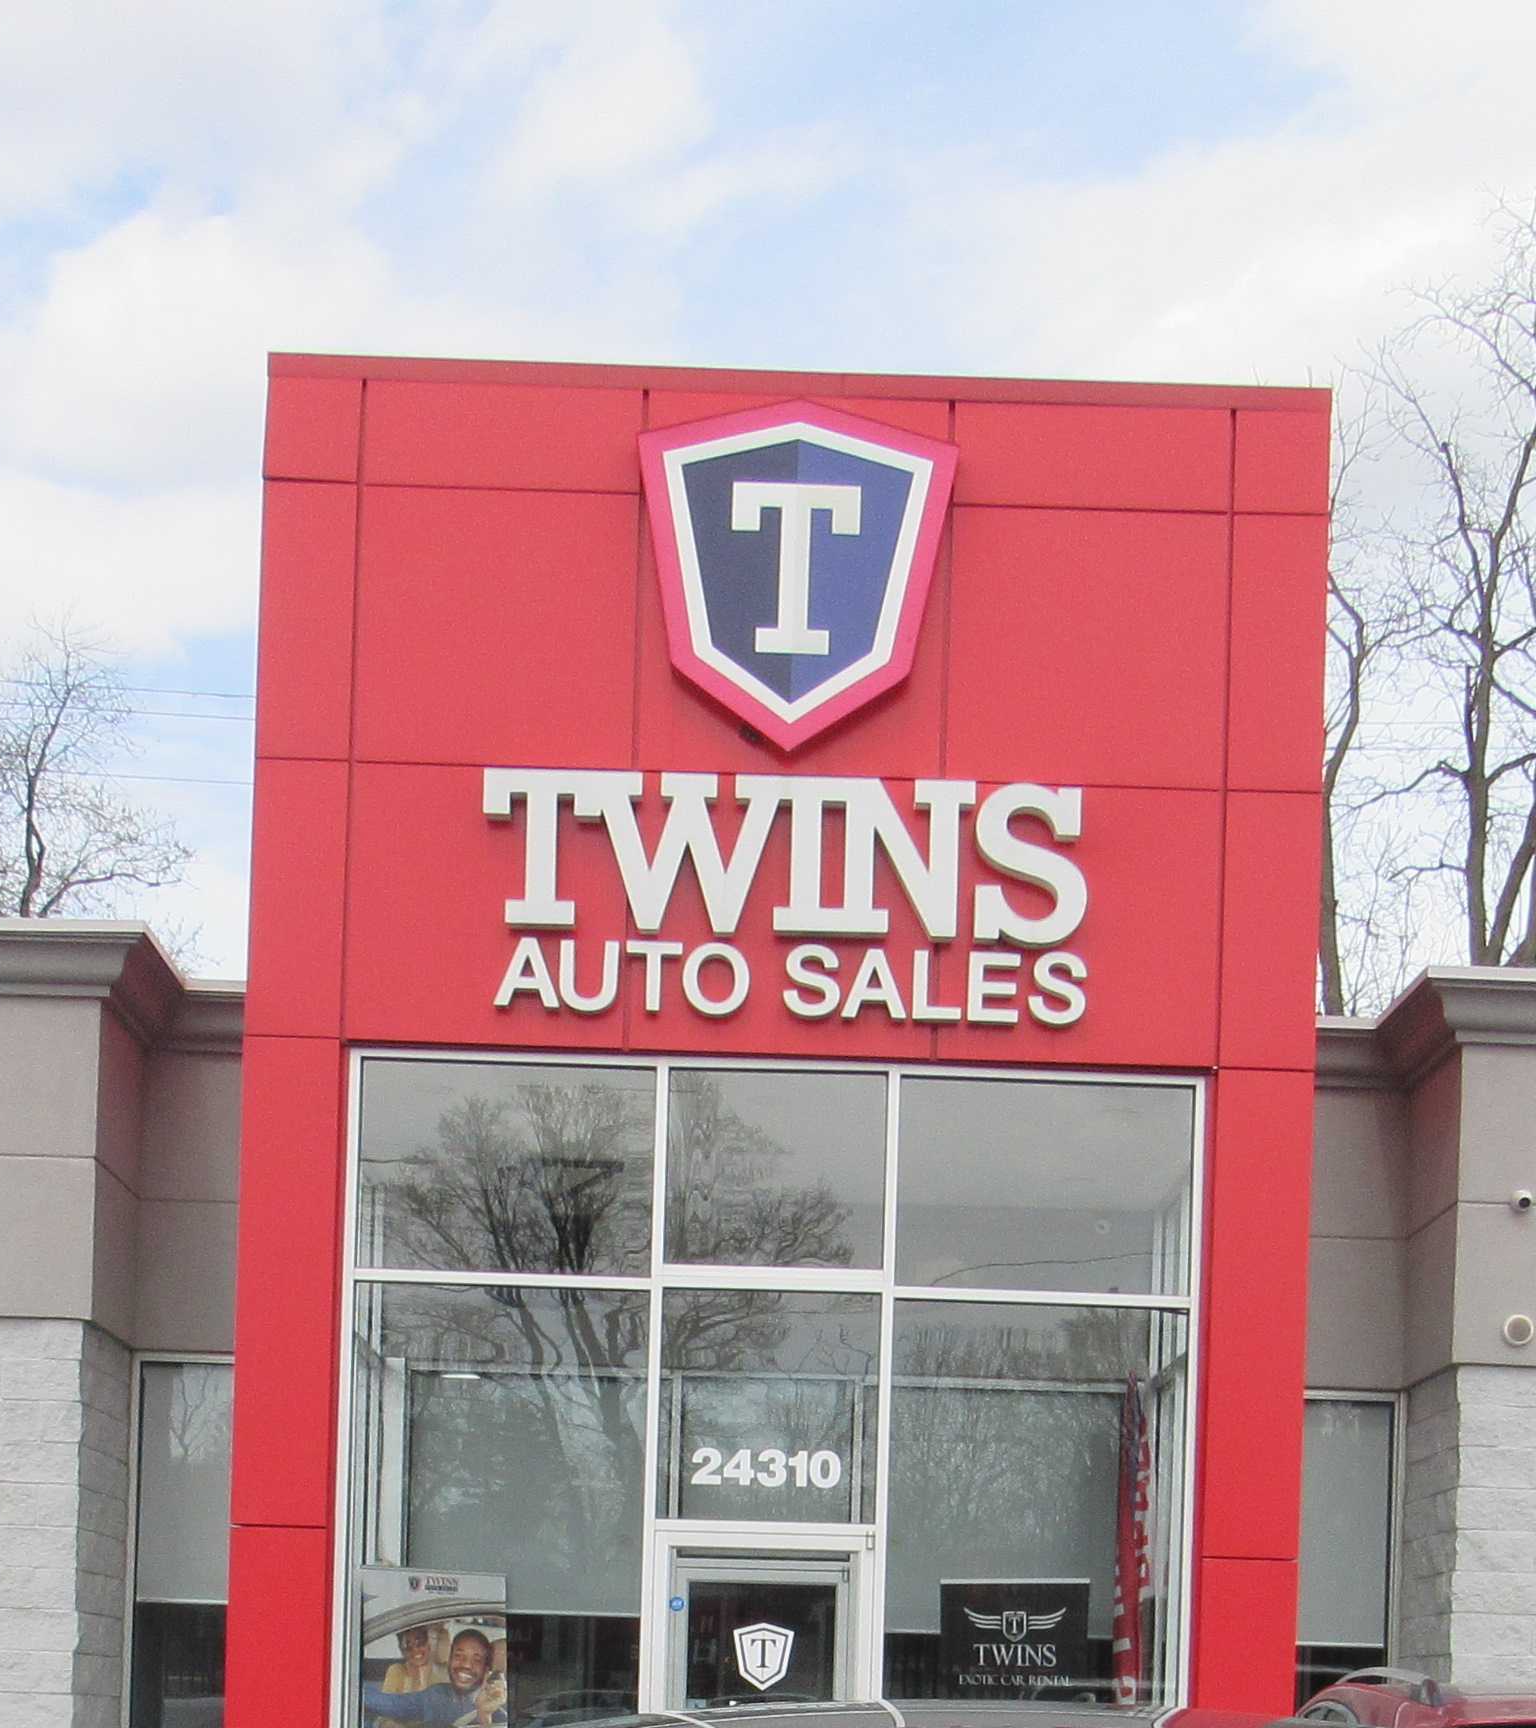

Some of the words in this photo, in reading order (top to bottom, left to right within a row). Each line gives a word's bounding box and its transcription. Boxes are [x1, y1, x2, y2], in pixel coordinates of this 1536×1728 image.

[731, 481, 861, 656] T
[482, 768, 1088, 947] TWINS
[493, 936, 751, 1020] AUTO
[781, 945, 1088, 1028] SALES
[690, 1447, 842, 1489] 24310
[750, 1637, 777, 1669] T
[972, 1643, 1057, 1668] TWINS
[959, 1674, 998, 1686] EXOTIC
[1000, 1675, 1026, 1686] CAR
[1028, 1675, 1072, 1687] RENTAL
